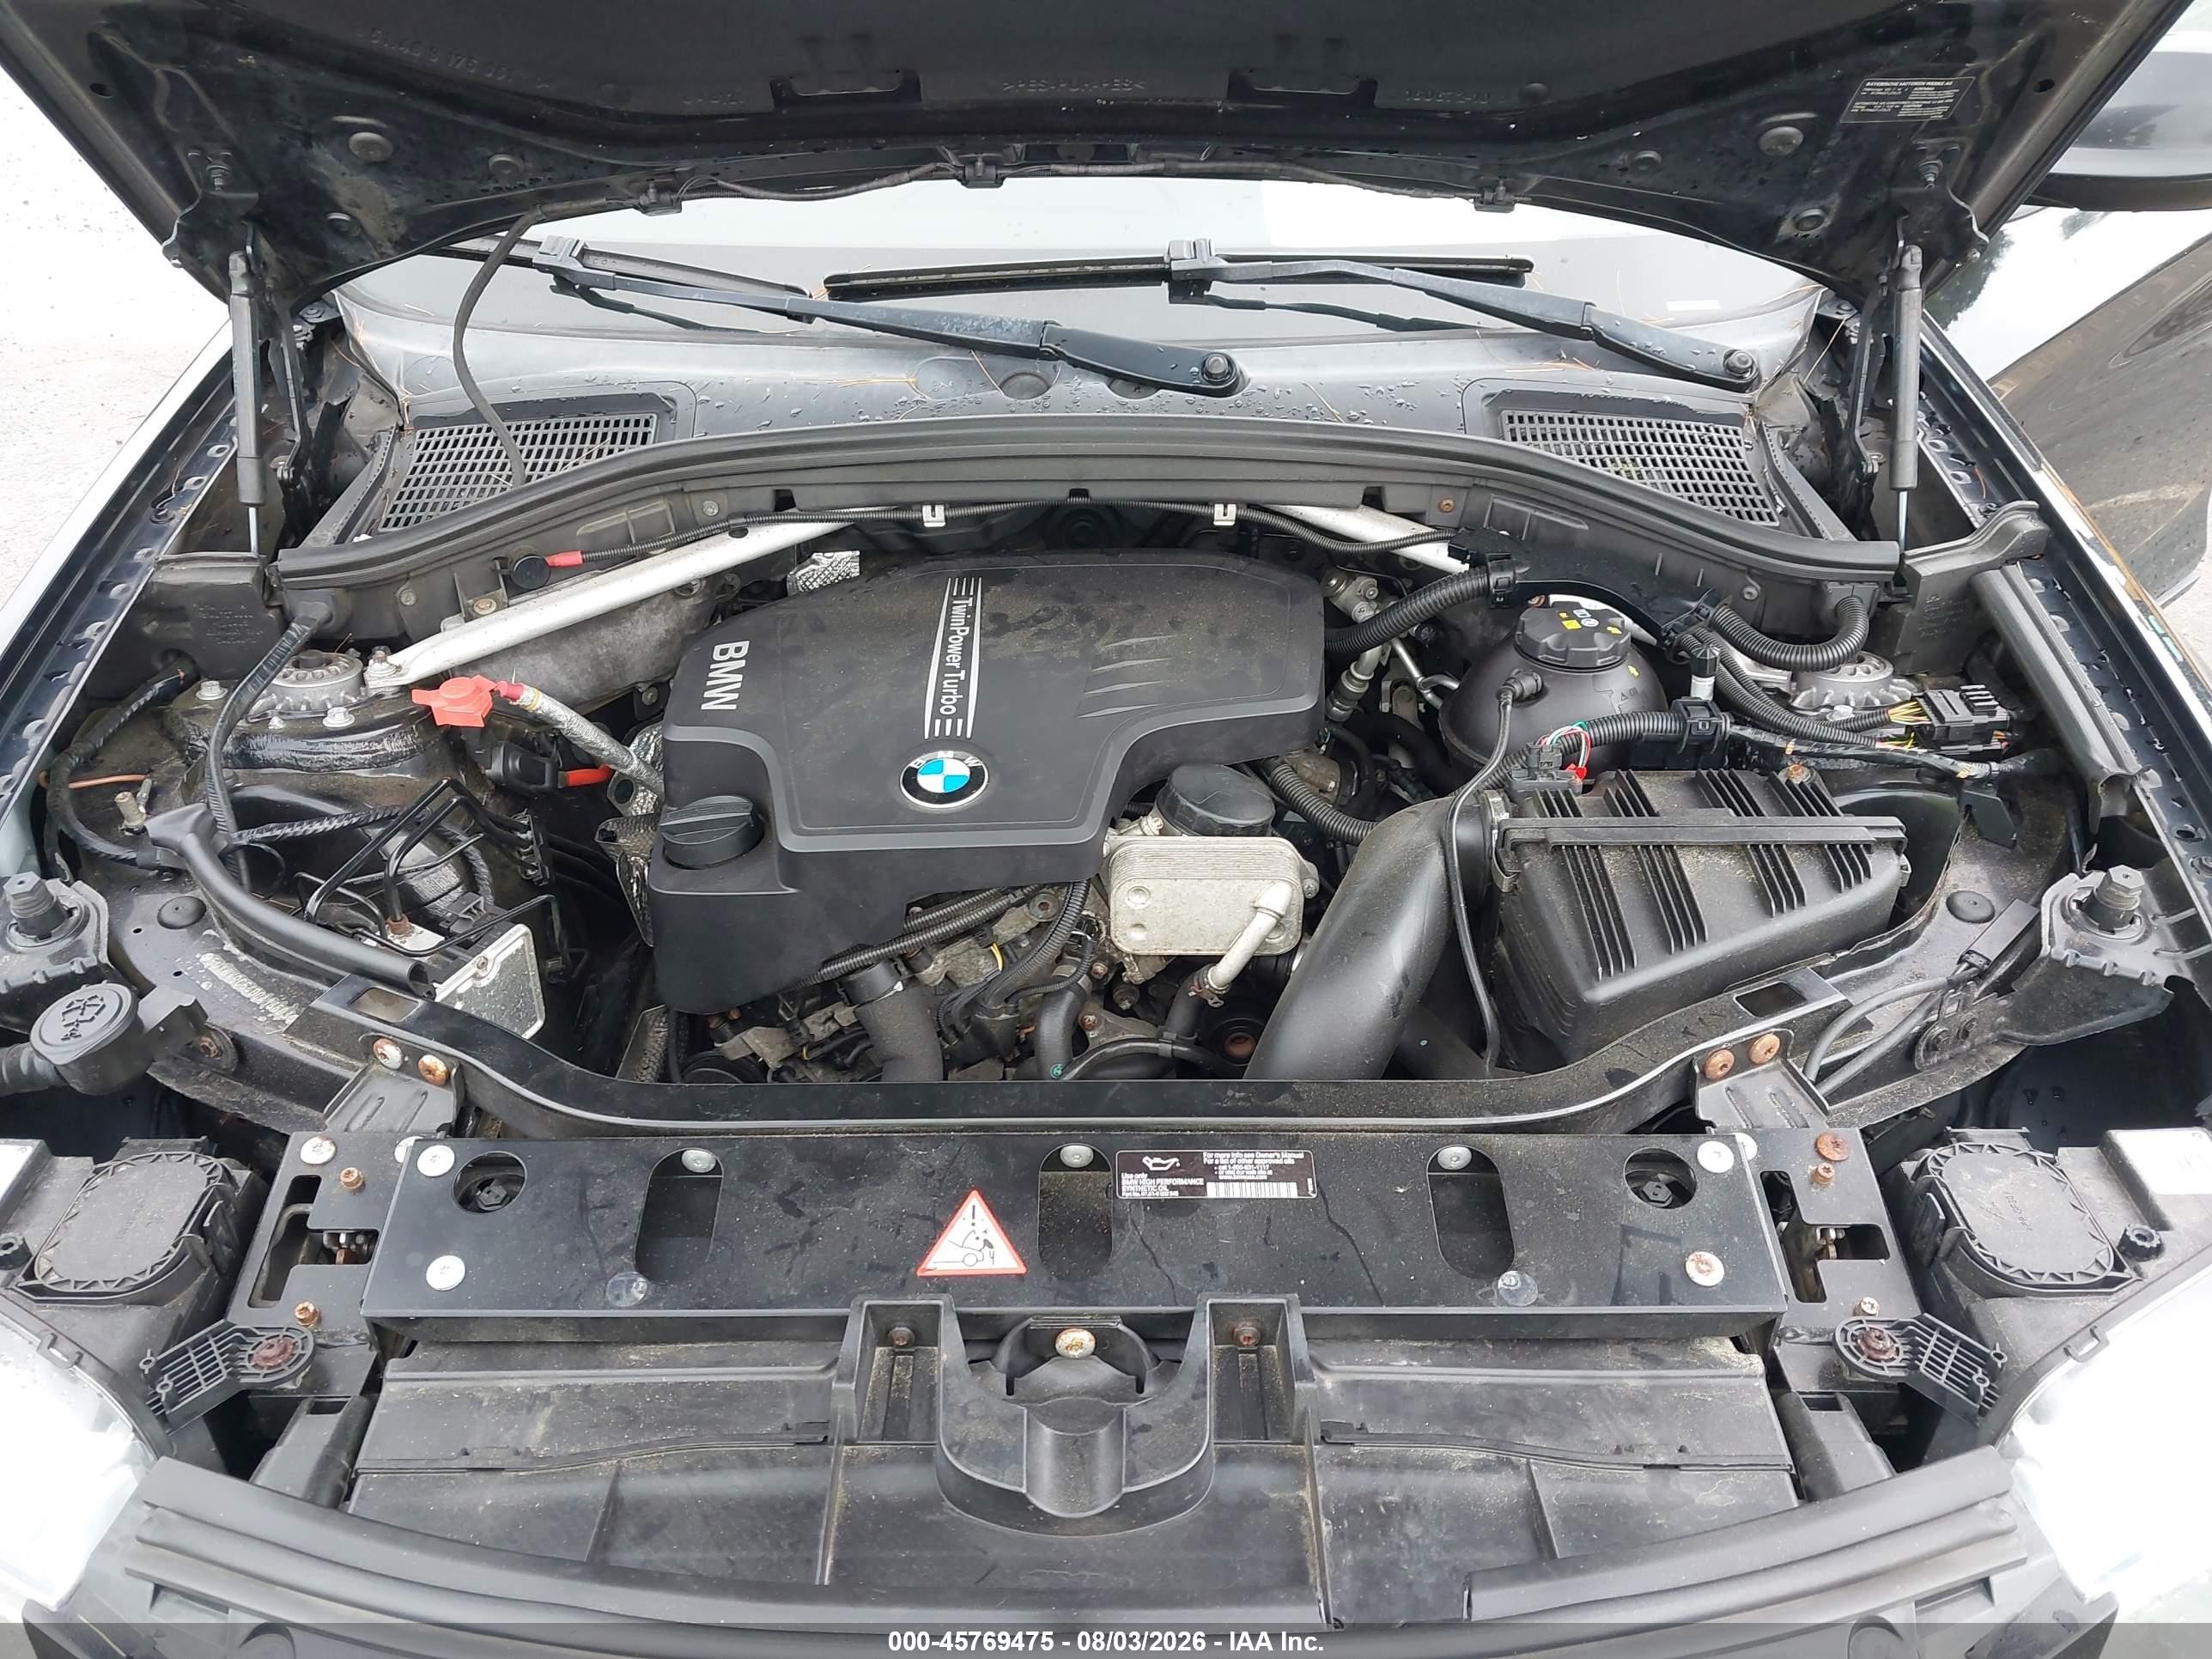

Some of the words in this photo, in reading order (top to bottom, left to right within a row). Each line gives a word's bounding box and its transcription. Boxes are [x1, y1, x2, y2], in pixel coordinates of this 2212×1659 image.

[945, 597, 973, 667] TwinPower
[701, 641, 750, 709] BMW
[939, 670, 965, 715] Turbo
[911, 750, 983, 769] BMW
